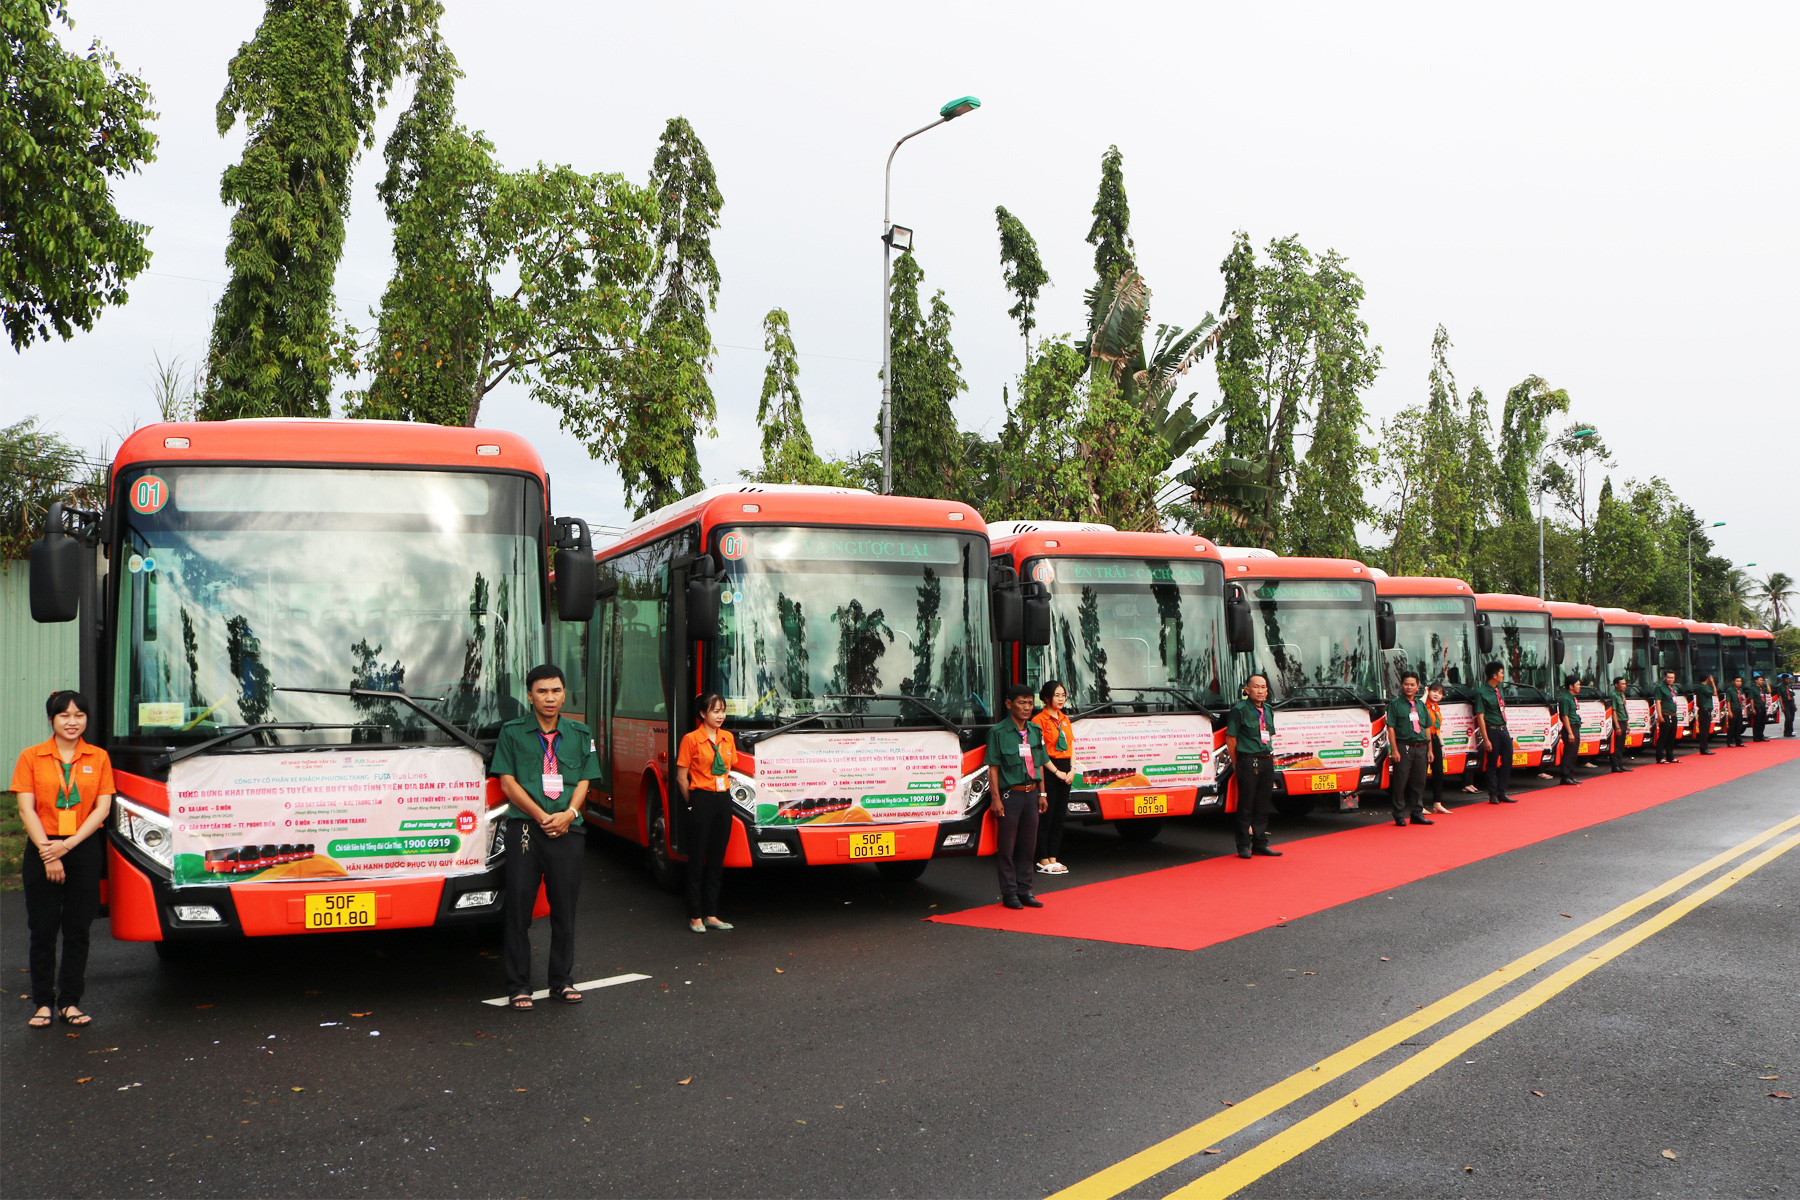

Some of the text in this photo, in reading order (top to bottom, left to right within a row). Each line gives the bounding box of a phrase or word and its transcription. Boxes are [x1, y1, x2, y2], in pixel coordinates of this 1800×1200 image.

[137, 482, 160, 507] 01
[726, 537, 743, 556] 01
[803, 537, 929, 559] VÀ NGƯỢC LẠI
[1036, 566, 1050, 581] 01
[1094, 565, 1127, 578] TRÃI
[1136, 566, 1171, 580] CÁCH
[1143, 796, 1157, 804] 50F
[1138, 805, 1164, 813] 001.90
[403, 838, 451, 849] 1900 6919
[863, 834, 882, 844] 50F
[855, 845, 890, 856] 001.91
[346, 863, 361, 871] HÂN
[363, 863, 383, 872] HẠNH
[407, 861, 426, 870] PHỤC
[428, 860, 437, 869] VỤ
[438, 858, 453, 867] QUÝ
[455, 857, 479, 866] KHÁCH
[326, 895, 355, 909] 50F
[313, 911, 368, 926] 001.80
